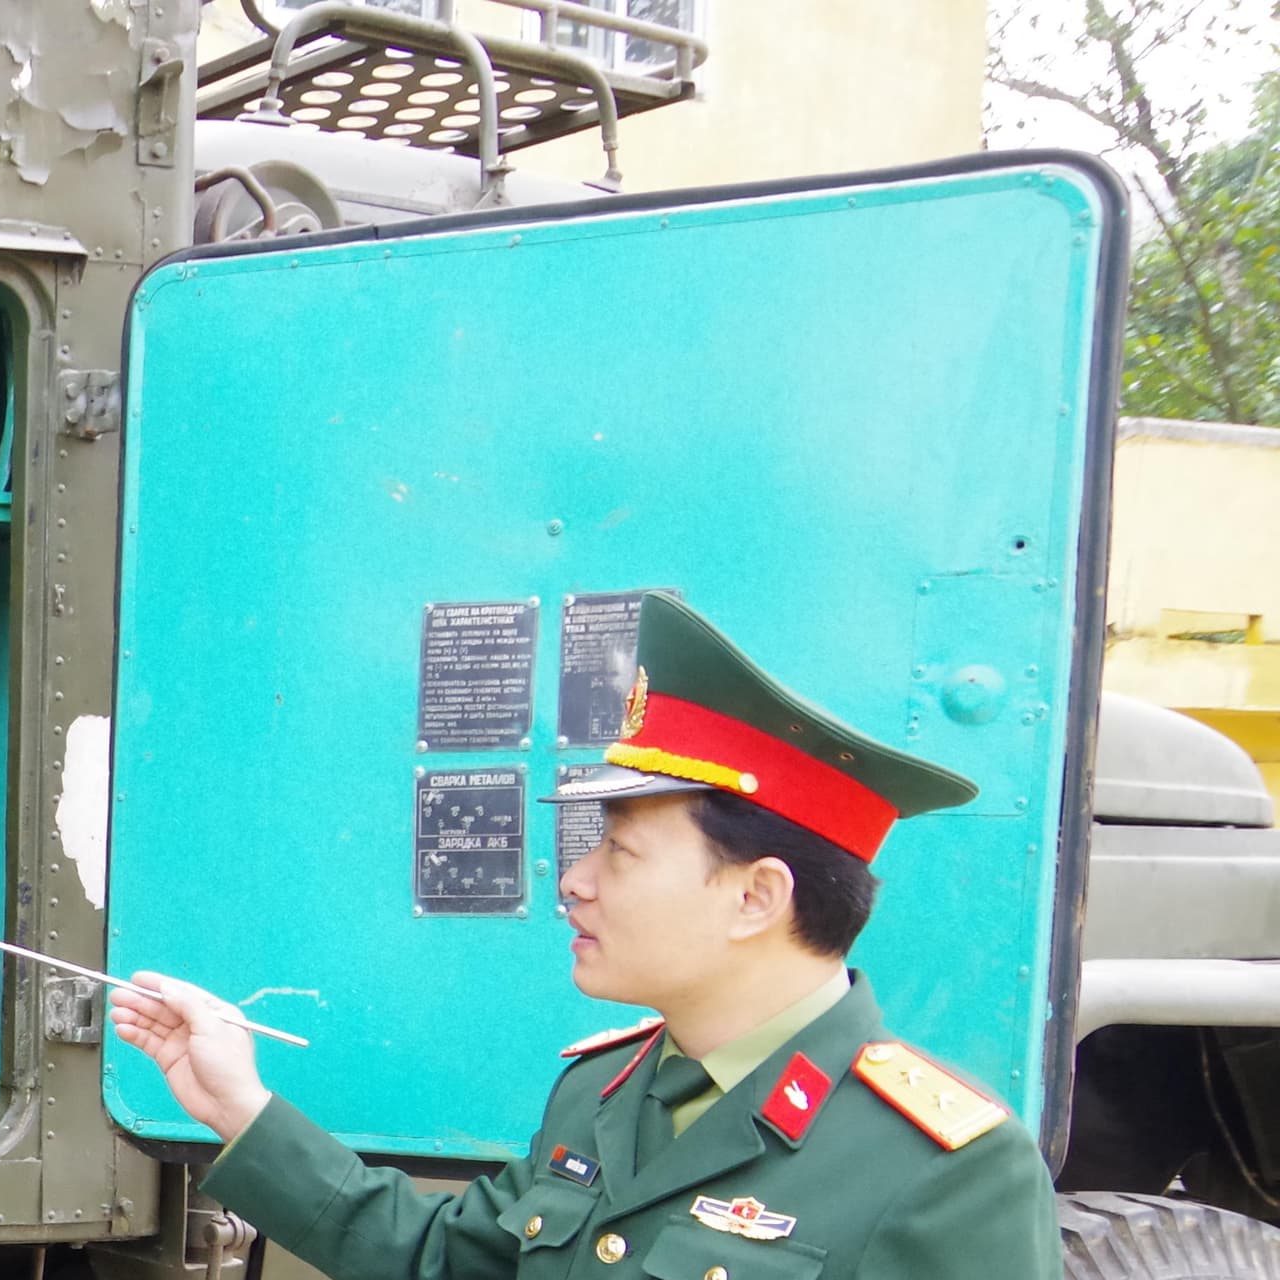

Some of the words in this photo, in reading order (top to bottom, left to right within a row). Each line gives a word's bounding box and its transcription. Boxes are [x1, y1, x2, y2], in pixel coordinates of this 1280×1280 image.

[430, 775, 466, 787] СВАРКА
[469, 773, 516, 786] МЕТАЛЛОВ
[438, 837, 482, 849] ЗАРЯДКА
[487, 836, 508, 849] АКБ
